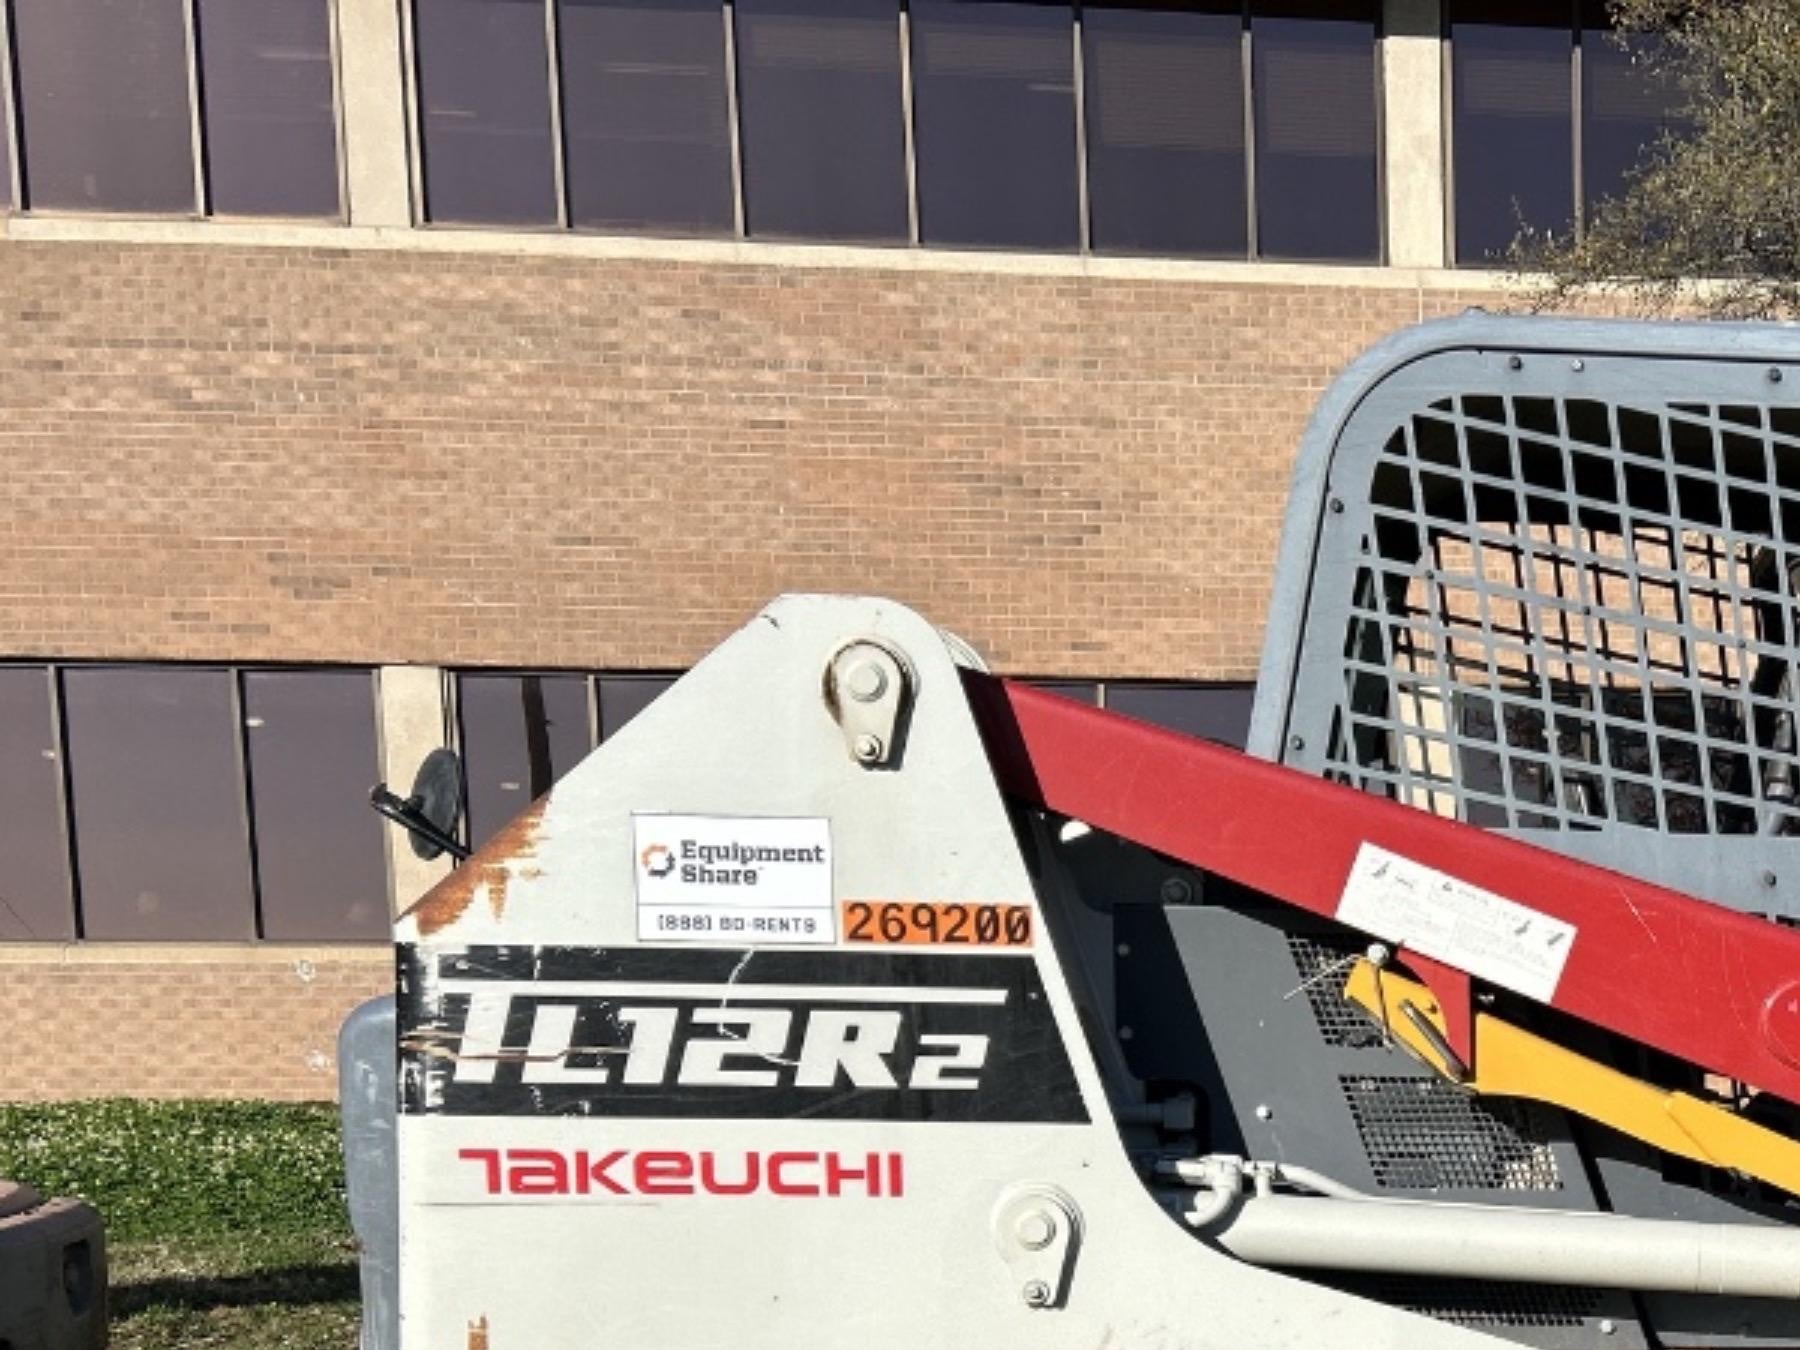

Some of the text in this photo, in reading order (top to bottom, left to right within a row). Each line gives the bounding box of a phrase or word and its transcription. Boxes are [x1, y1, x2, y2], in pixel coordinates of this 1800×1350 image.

[680, 839, 826, 866] Equipment
[681, 863, 759, 886] Share
[847, 902, 1031, 944] 269200
